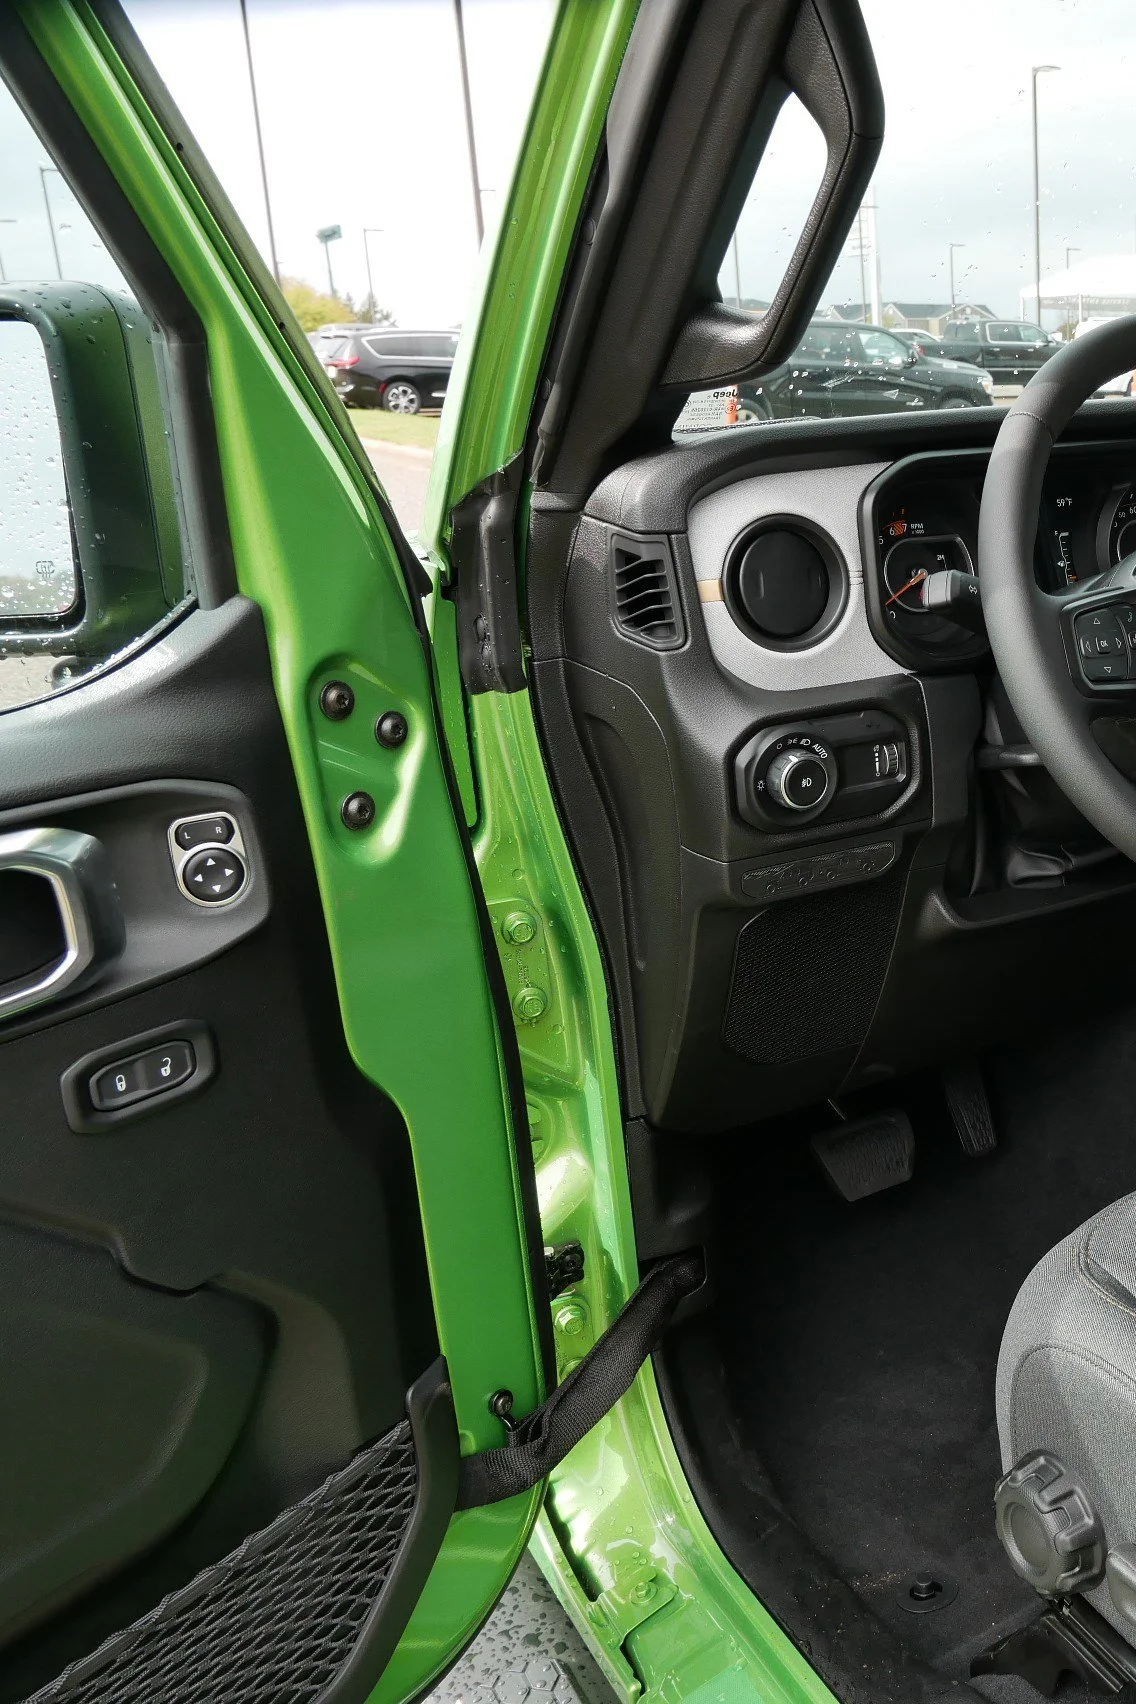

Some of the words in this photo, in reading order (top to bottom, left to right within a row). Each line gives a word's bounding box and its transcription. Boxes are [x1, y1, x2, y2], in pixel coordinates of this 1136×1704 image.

[889, 527, 895, 536] 6
[812, 743, 828, 759] AUTO
[215, 826, 222, 834] R
